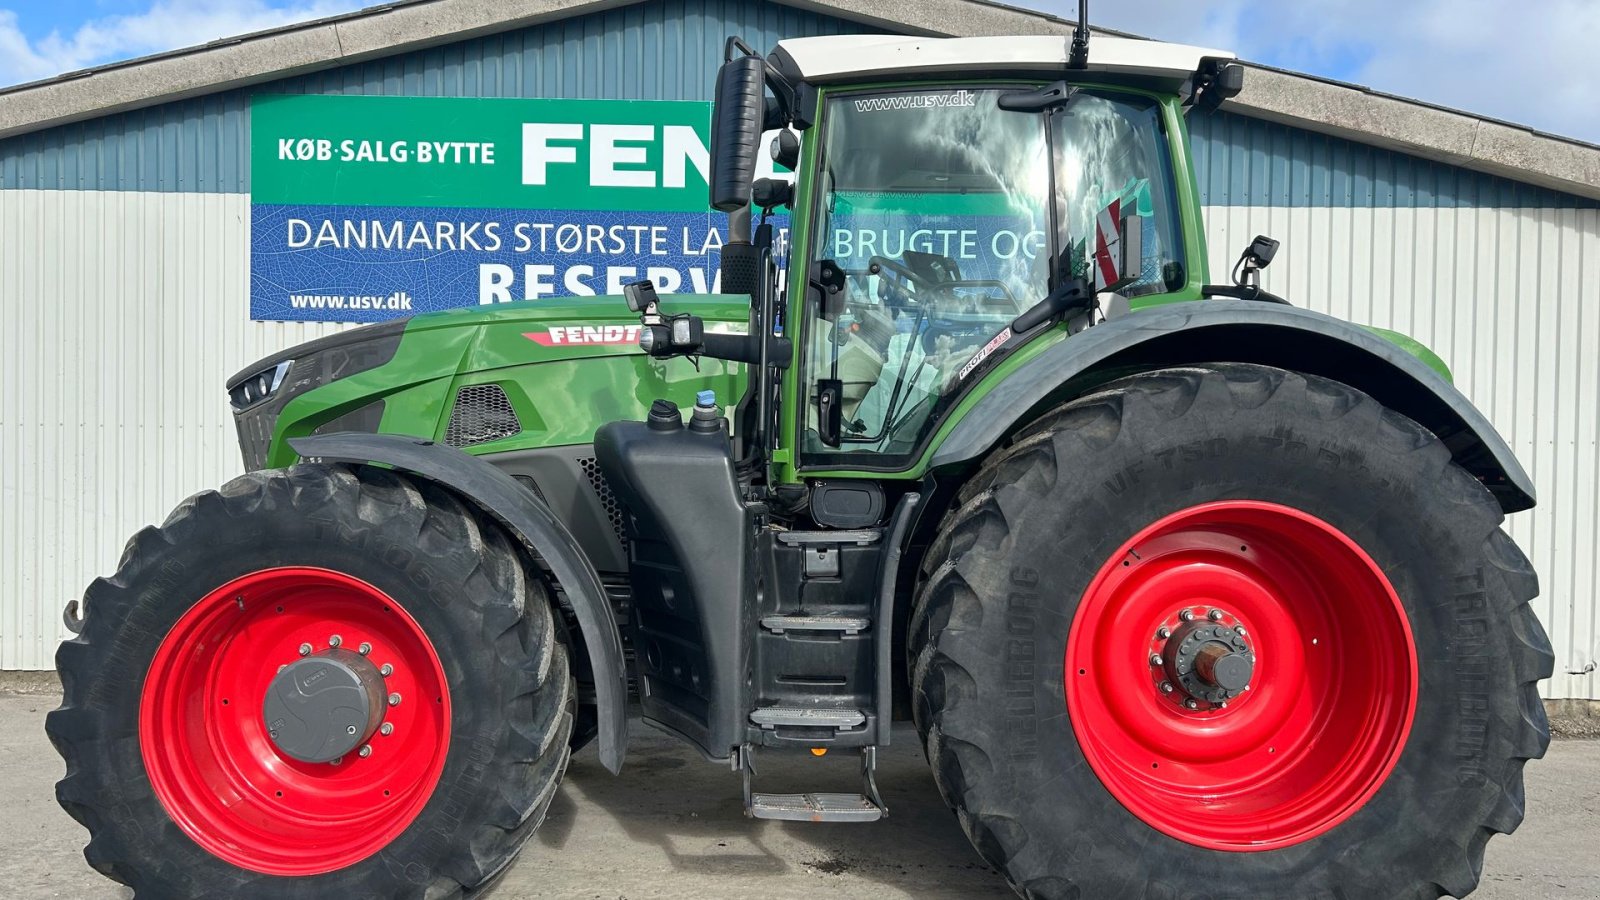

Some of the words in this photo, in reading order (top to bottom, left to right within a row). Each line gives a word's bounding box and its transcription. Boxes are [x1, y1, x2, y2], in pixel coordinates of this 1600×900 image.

[855, 90, 975, 112] www.usv.dk
[288, 217, 501, 252] DANMARKS
[514, 221, 669, 257] STØRSTE
[834, 228, 978, 259] BRUGTE
[992, 228, 1046, 260] OG
[479, 263, 722, 305] RESERV
[291, 292, 412, 312] www.usv.dk
[548, 324, 643, 344] FENDT
